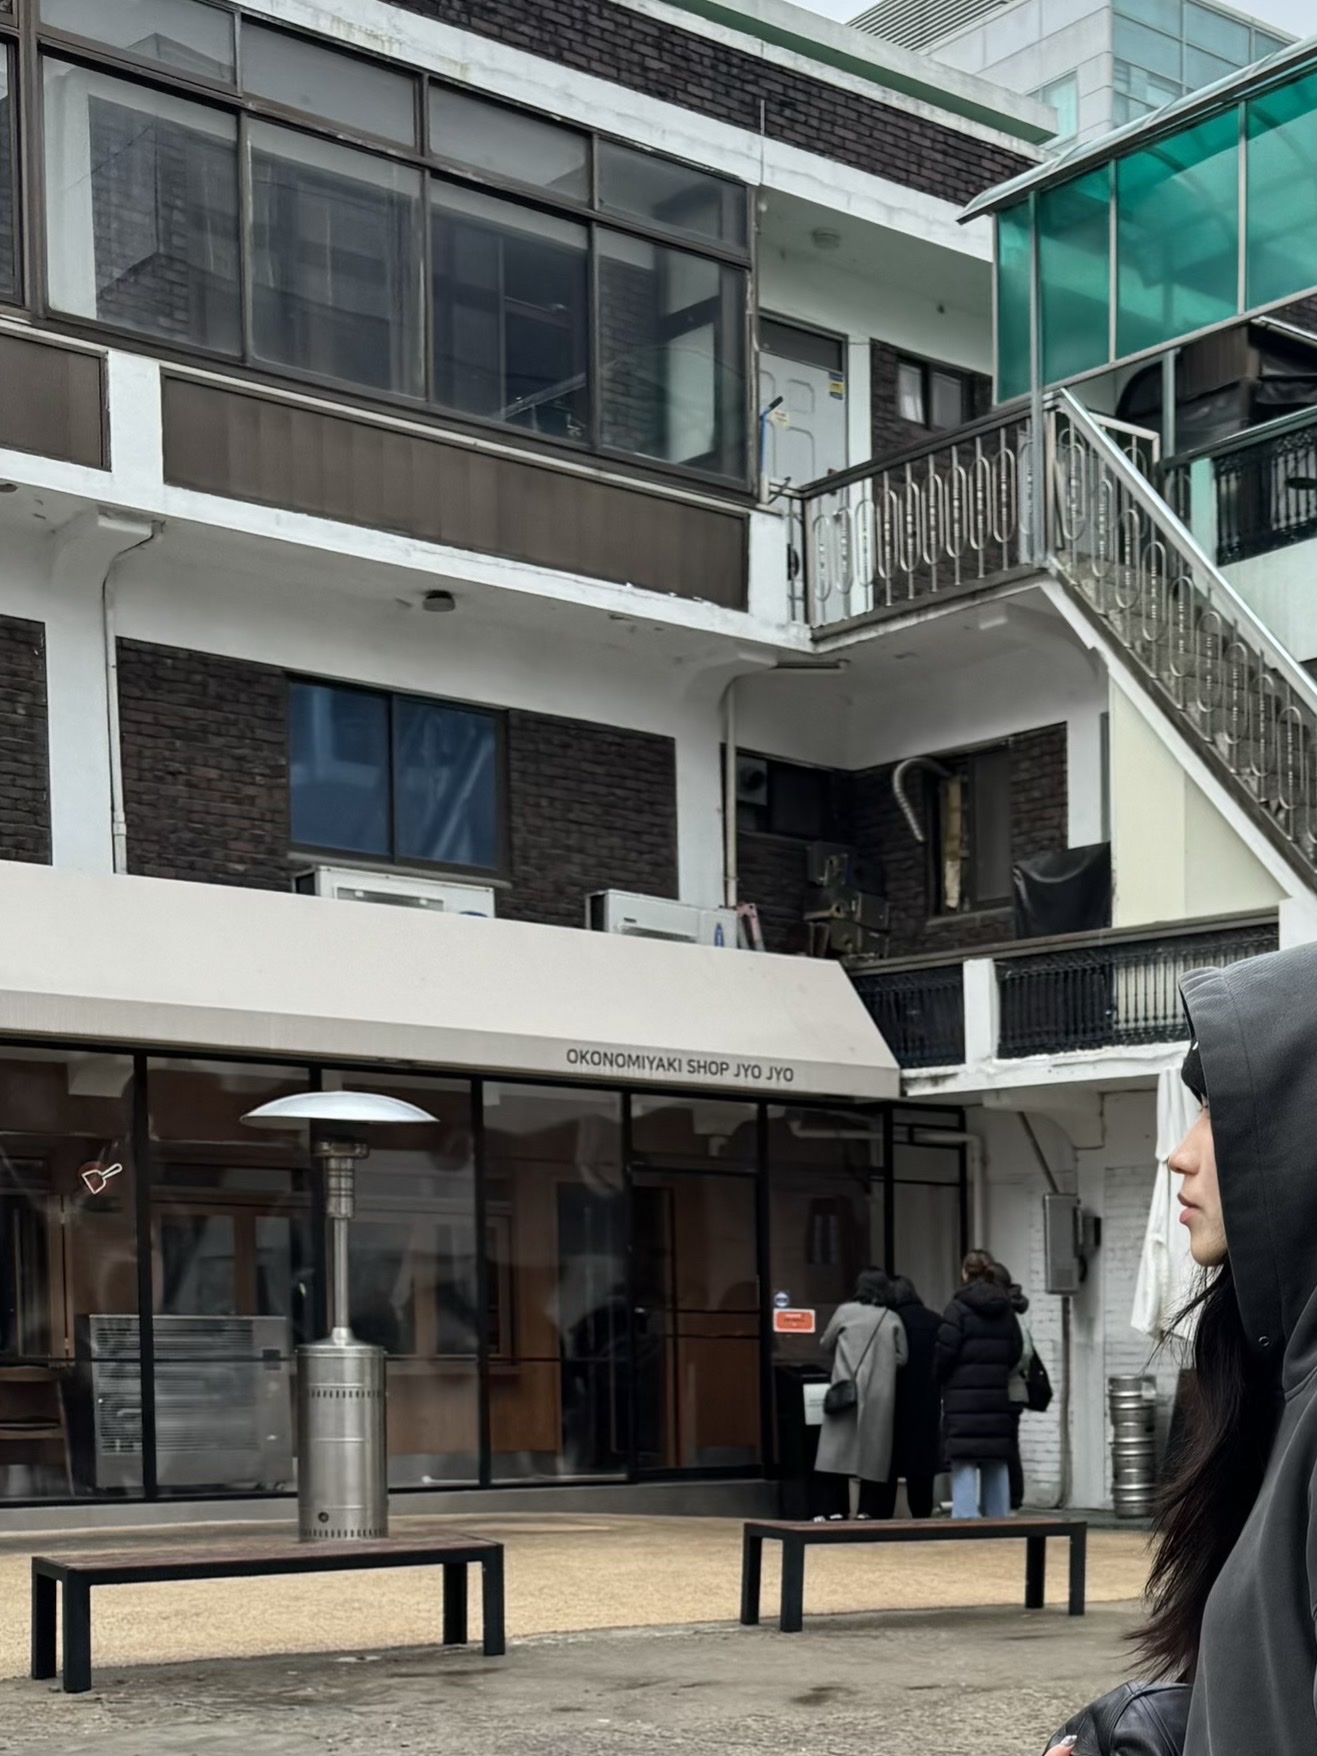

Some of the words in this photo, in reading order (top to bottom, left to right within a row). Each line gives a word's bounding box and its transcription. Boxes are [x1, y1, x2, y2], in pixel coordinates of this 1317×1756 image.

[566, 1048, 682, 1073] OKONOMIYAKI
[687, 1059, 730, 1077] SHOP
[733, 1063, 762, 1080] JYO
[766, 1066, 794, 1083] JYO
